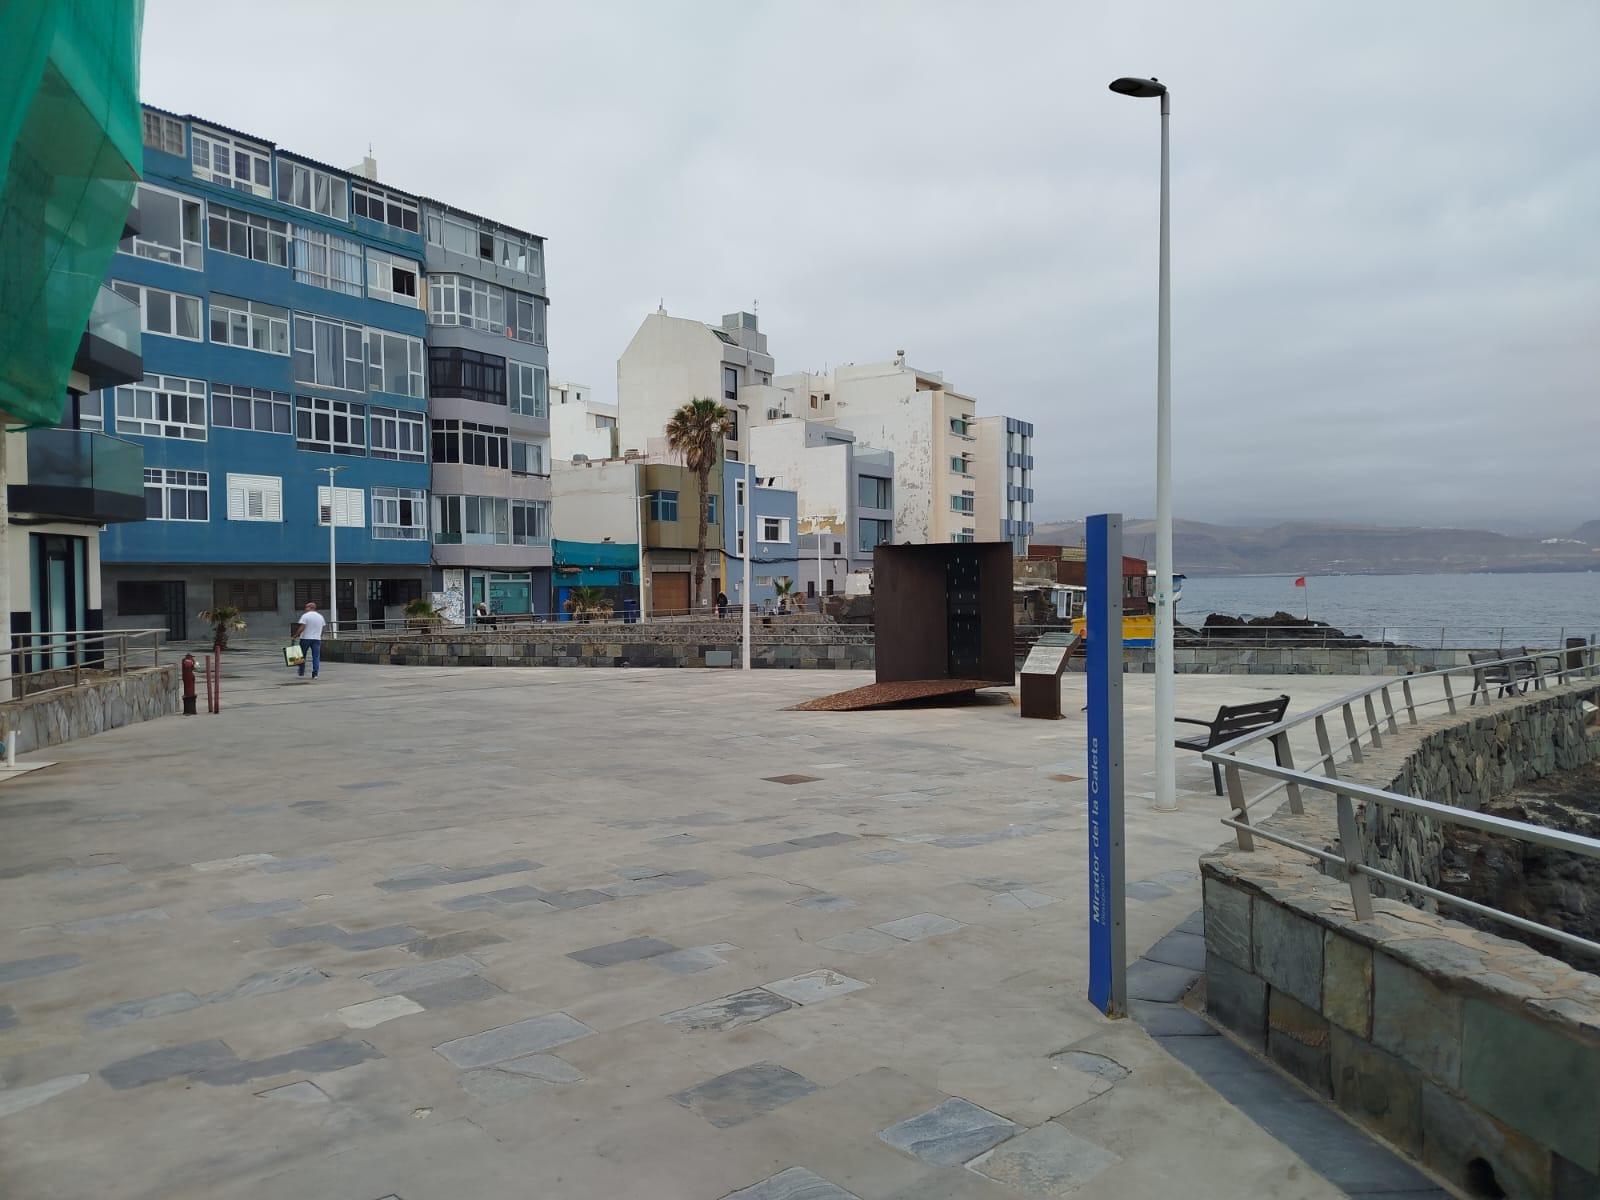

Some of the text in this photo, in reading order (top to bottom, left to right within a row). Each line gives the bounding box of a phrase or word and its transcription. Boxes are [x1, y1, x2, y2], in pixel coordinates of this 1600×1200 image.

[1091, 737, 1099, 794] Caleta
[1092, 800, 1099, 816] la
[1092, 852, 1100, 923] Mirador
